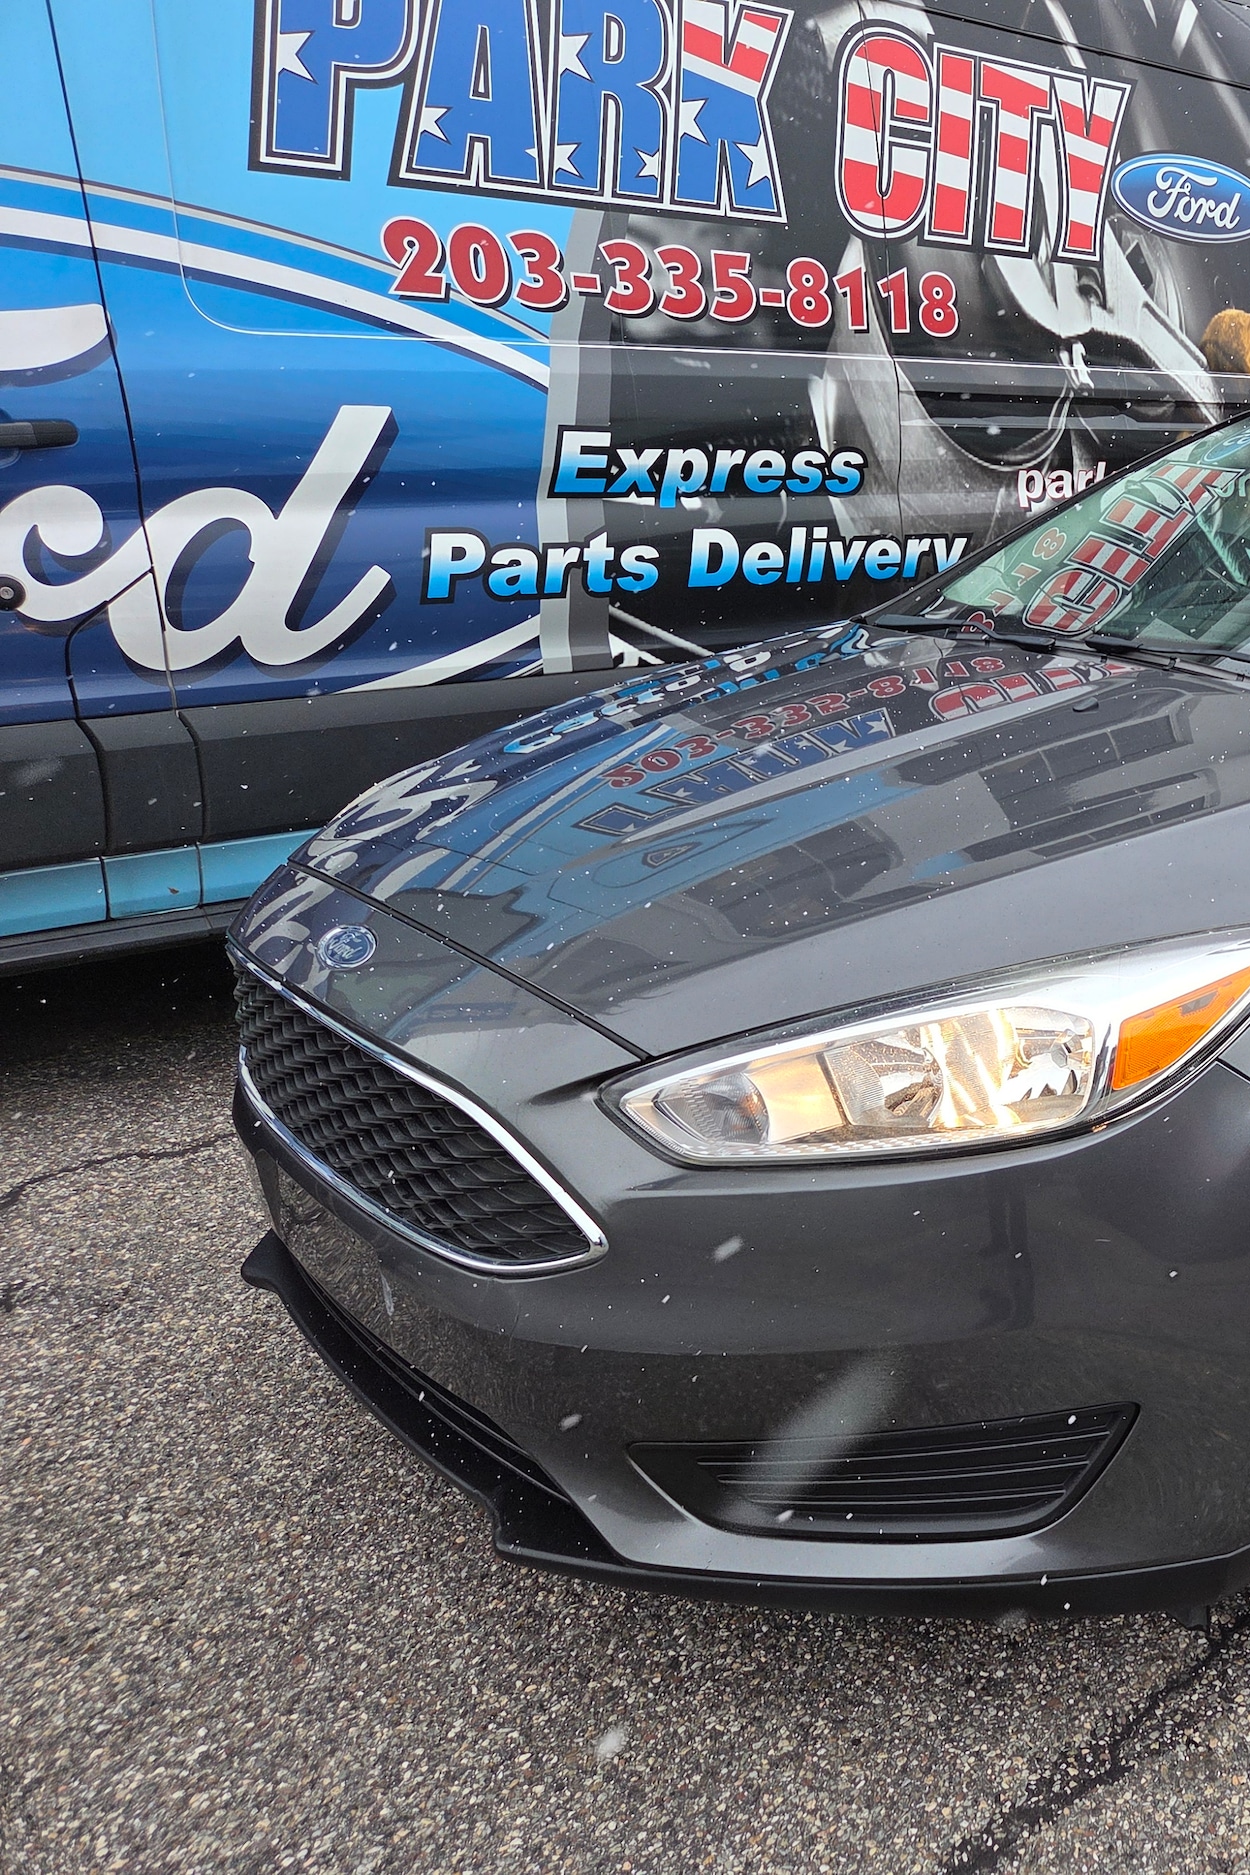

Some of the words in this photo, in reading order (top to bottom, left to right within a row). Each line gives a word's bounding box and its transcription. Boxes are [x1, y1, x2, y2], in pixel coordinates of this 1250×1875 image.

[249, 0, 795, 223] PARK
[836, 25, 1135, 261] CITY
[1147, 167, 1241, 231] Ford
[381, 216, 959, 338] 203-335-8118
[550, 426, 867, 508] Express
[422, 529, 661, 602] Parts
[688, 527, 968, 589] Delivery
